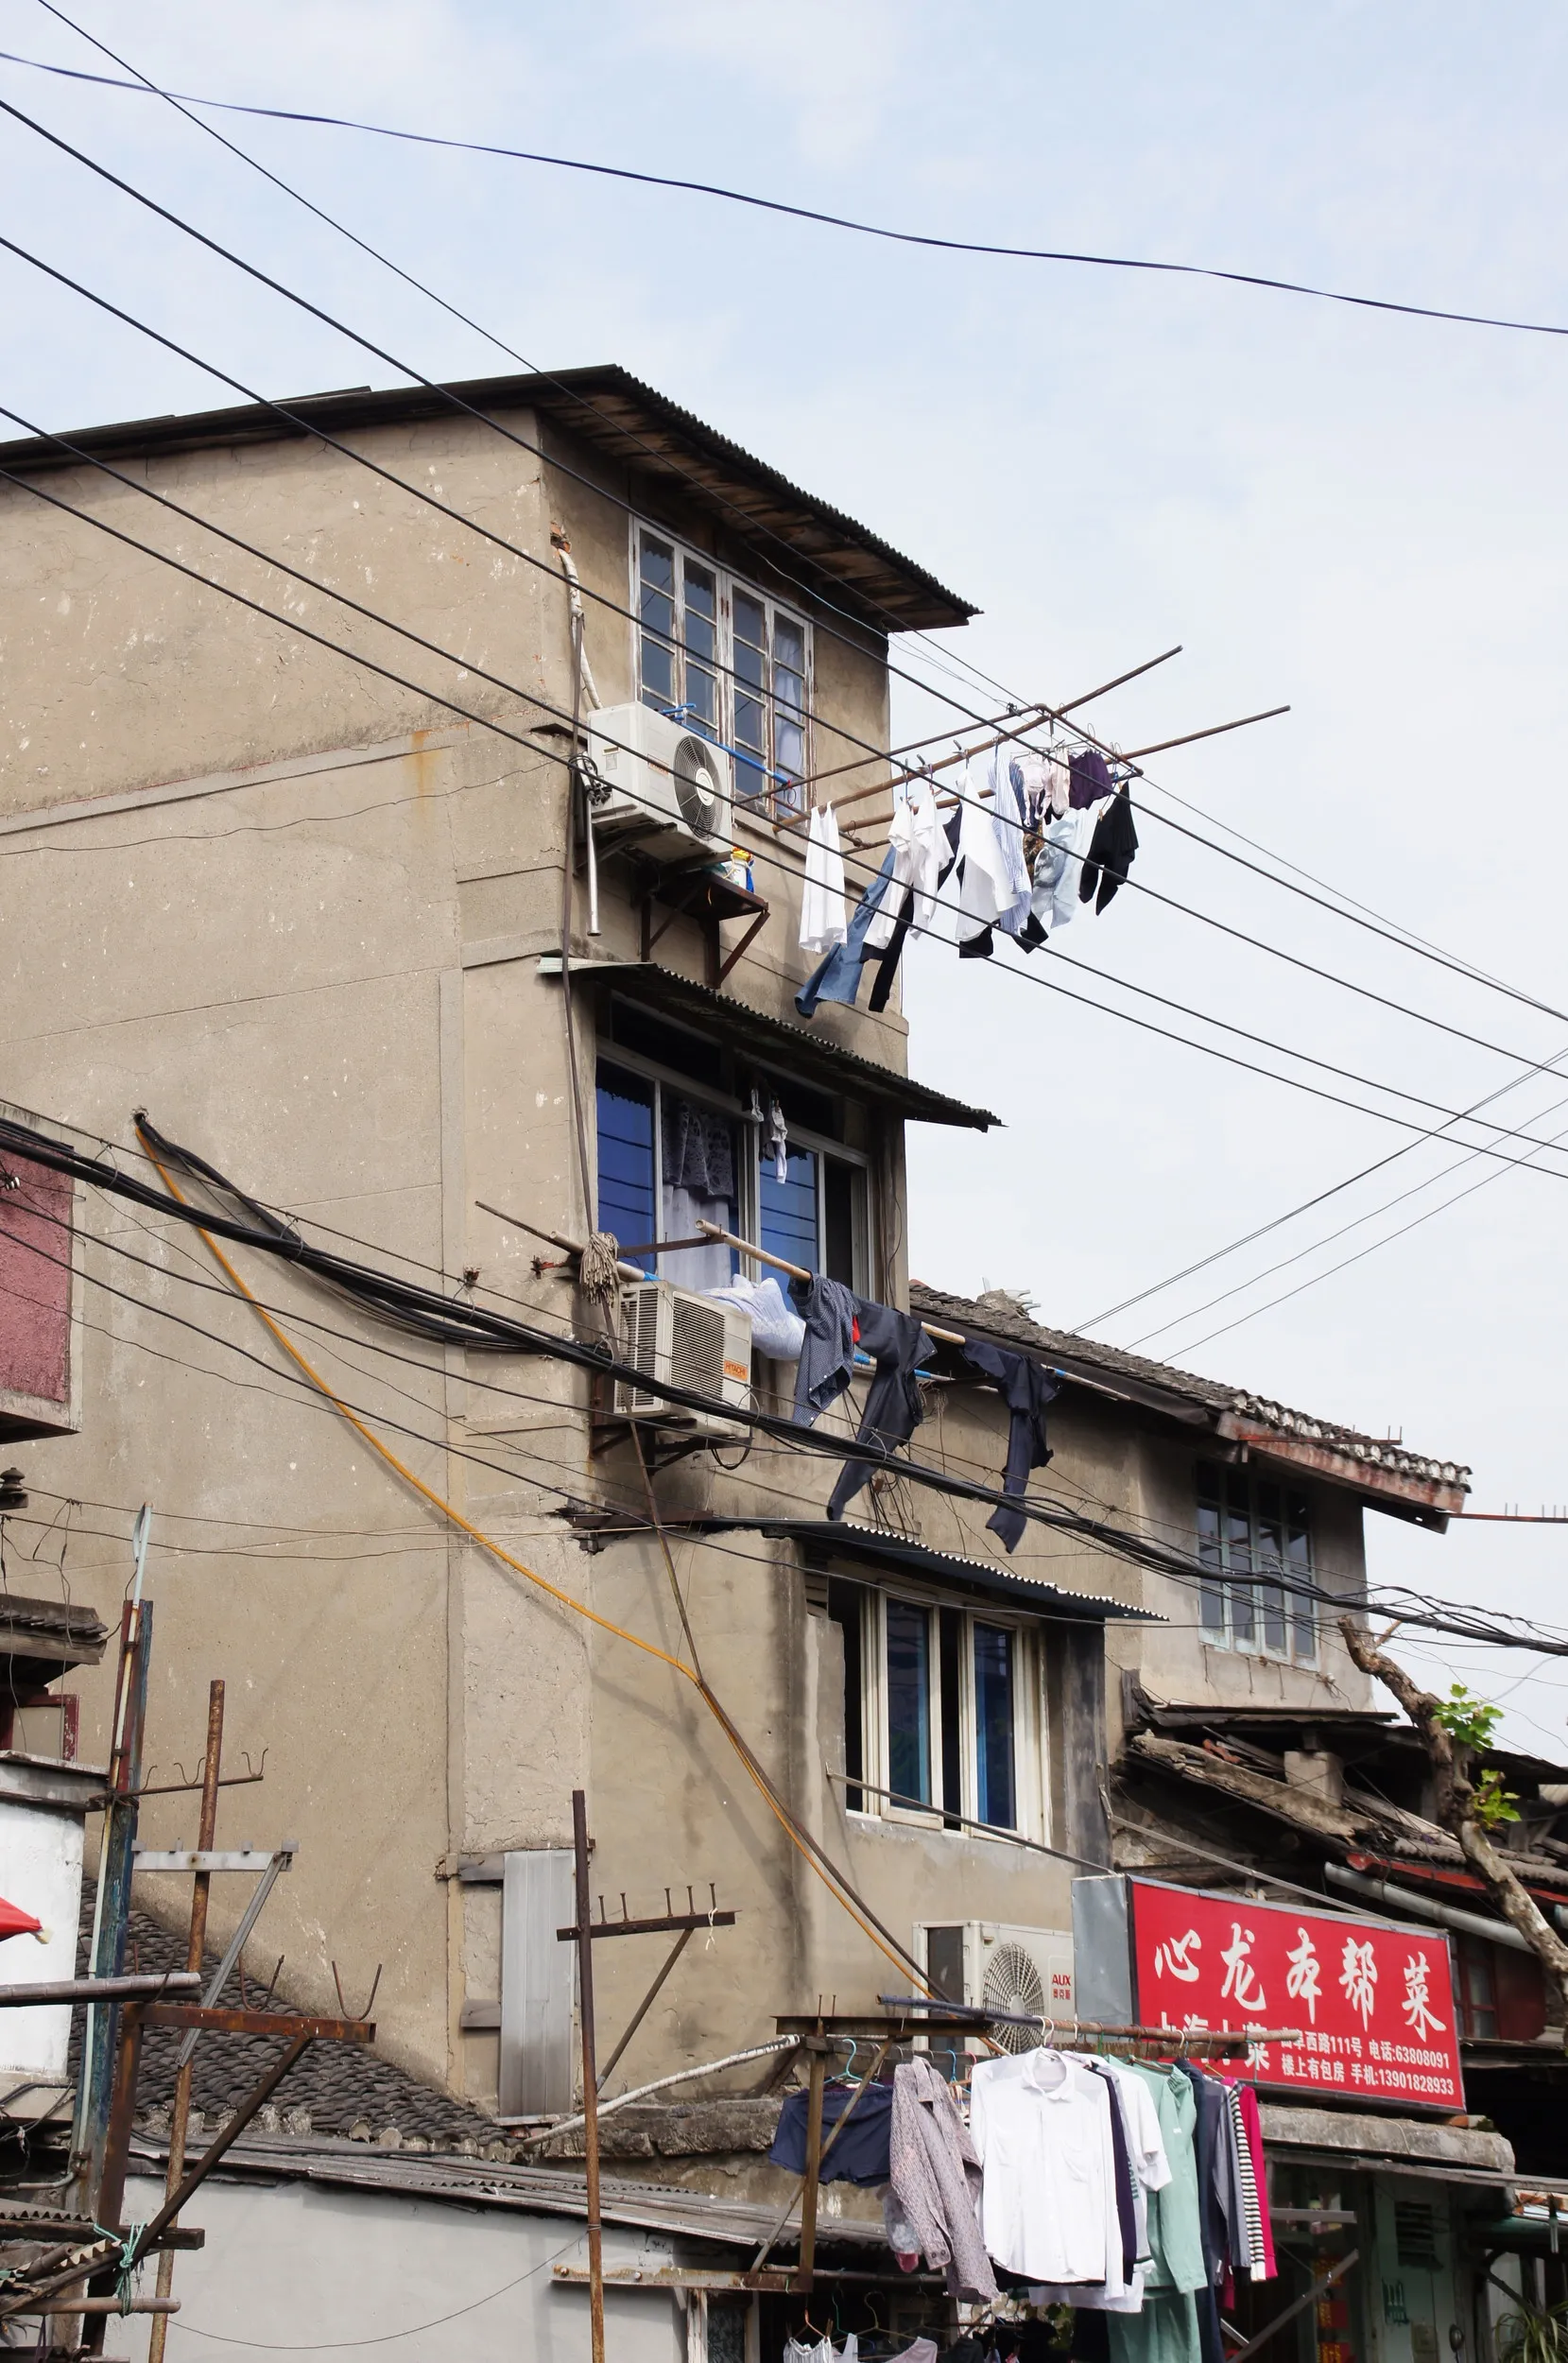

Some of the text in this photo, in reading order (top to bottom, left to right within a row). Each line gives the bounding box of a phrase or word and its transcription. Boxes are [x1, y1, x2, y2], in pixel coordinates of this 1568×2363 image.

[1052, 1974, 1071, 1986] AUX
[1154, 1922, 1447, 2043] 心龙本帮菜
[1281, 2053, 1345, 2083] 楼上有包房
[1370, 2039, 1450, 2070] 电话:63808091
